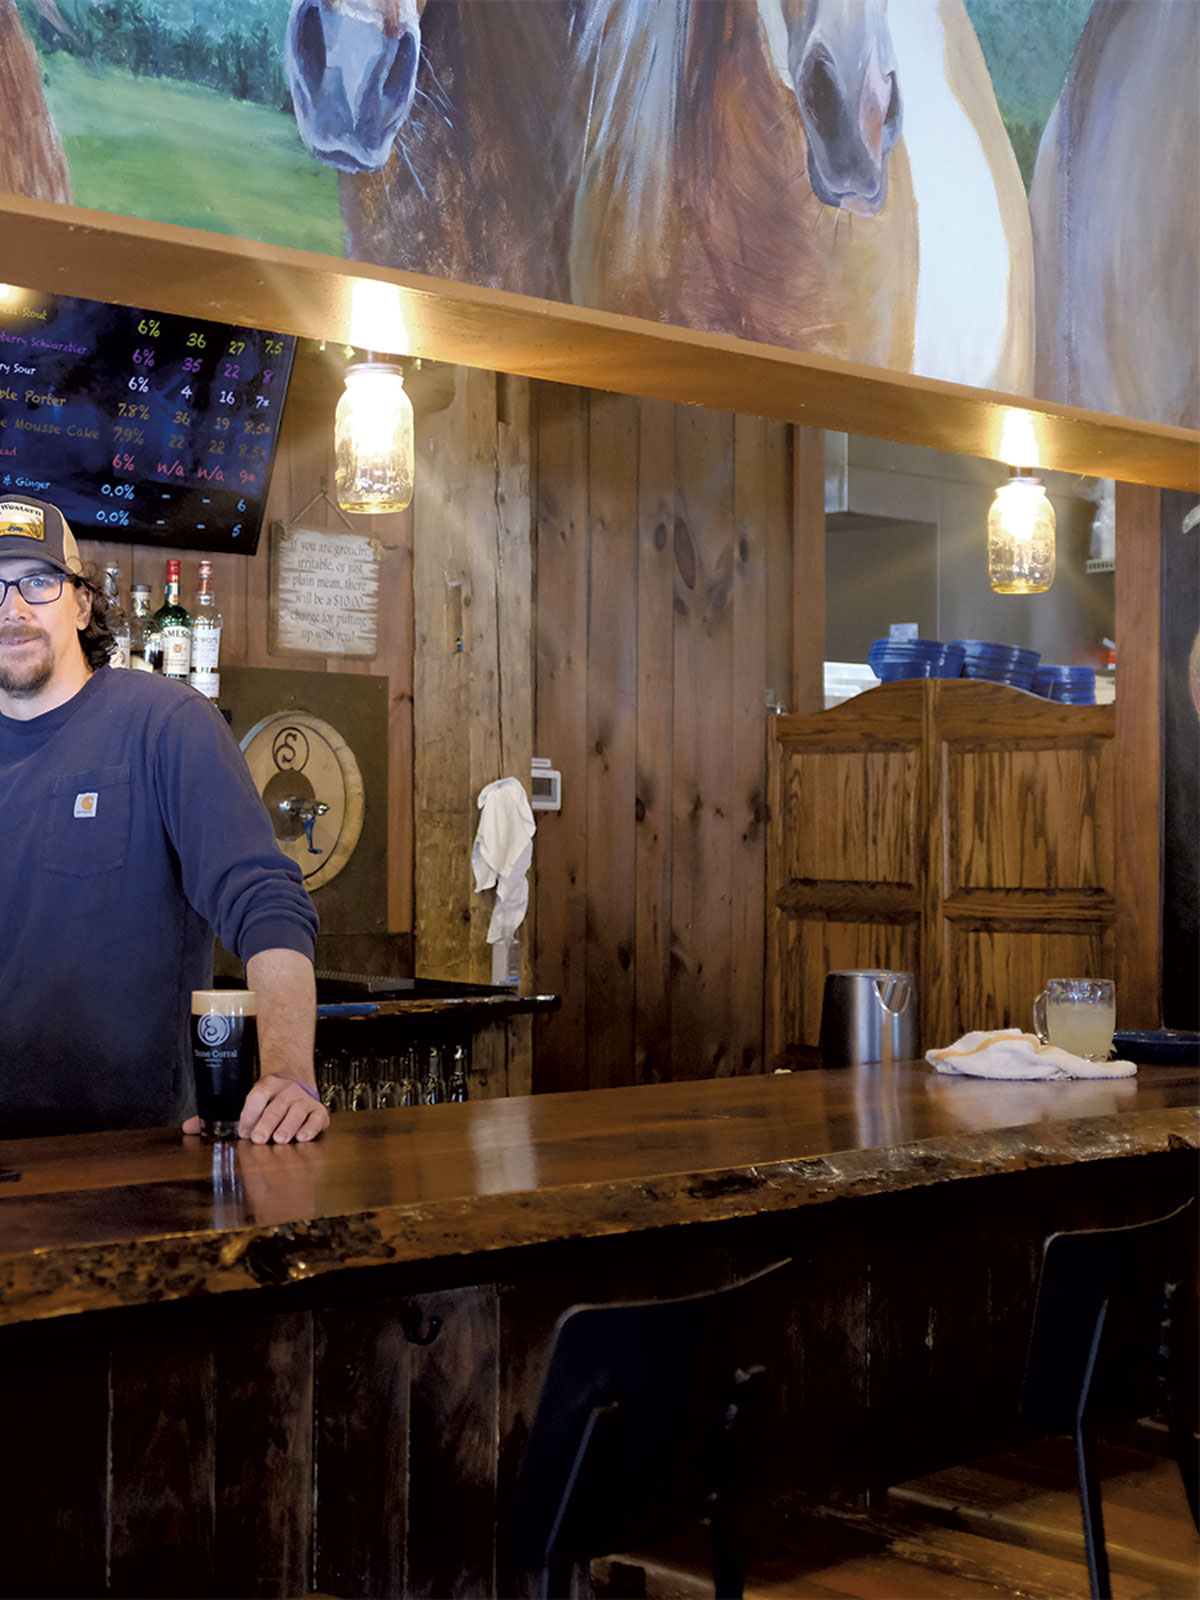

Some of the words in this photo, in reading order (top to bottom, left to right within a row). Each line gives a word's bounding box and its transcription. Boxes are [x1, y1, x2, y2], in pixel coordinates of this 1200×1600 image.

[22, 306, 48, 320] Stout
[137, 319, 161, 338] 6%
[186, 332, 207, 349] 36
[228, 341, 245, 355] 27
[265, 340, 284, 355] 7.5
[31, 336, 88, 355] Schwarzbier
[132, 348, 155, 367] 6%
[181, 357, 203, 373] 35
[223, 364, 241, 379] 22
[262, 369, 273, 384] 8
[13, 363, 37, 376] Sour
[128, 377, 150, 393] 6%
[180, 385, 193, 399] 4
[219, 391, 235, 405] 16
[24, 390, 67, 408] Porter
[117, 403, 150, 421] 7.8%
[172, 411, 191, 425] 36
[214, 417, 230, 430] 19
[14, 418, 61, 435] Mousse
[66, 425, 101, 440] Cake
[113, 425, 145, 446] 7.9%
[168, 434, 186, 450] 22
[209, 440, 225, 455] 22
[112, 453, 135, 472] 6%
[157, 461, 185, 478] n/a
[197, 465, 225, 483] n/a
[15, 476, 51, 492] Ginger
[100, 483, 135, 501] 0.0%
[237, 499, 247, 513] 6
[95, 510, 130, 527] 0.0%
[232, 523, 242, 537] 5
[314, 592, 324, 605] be
